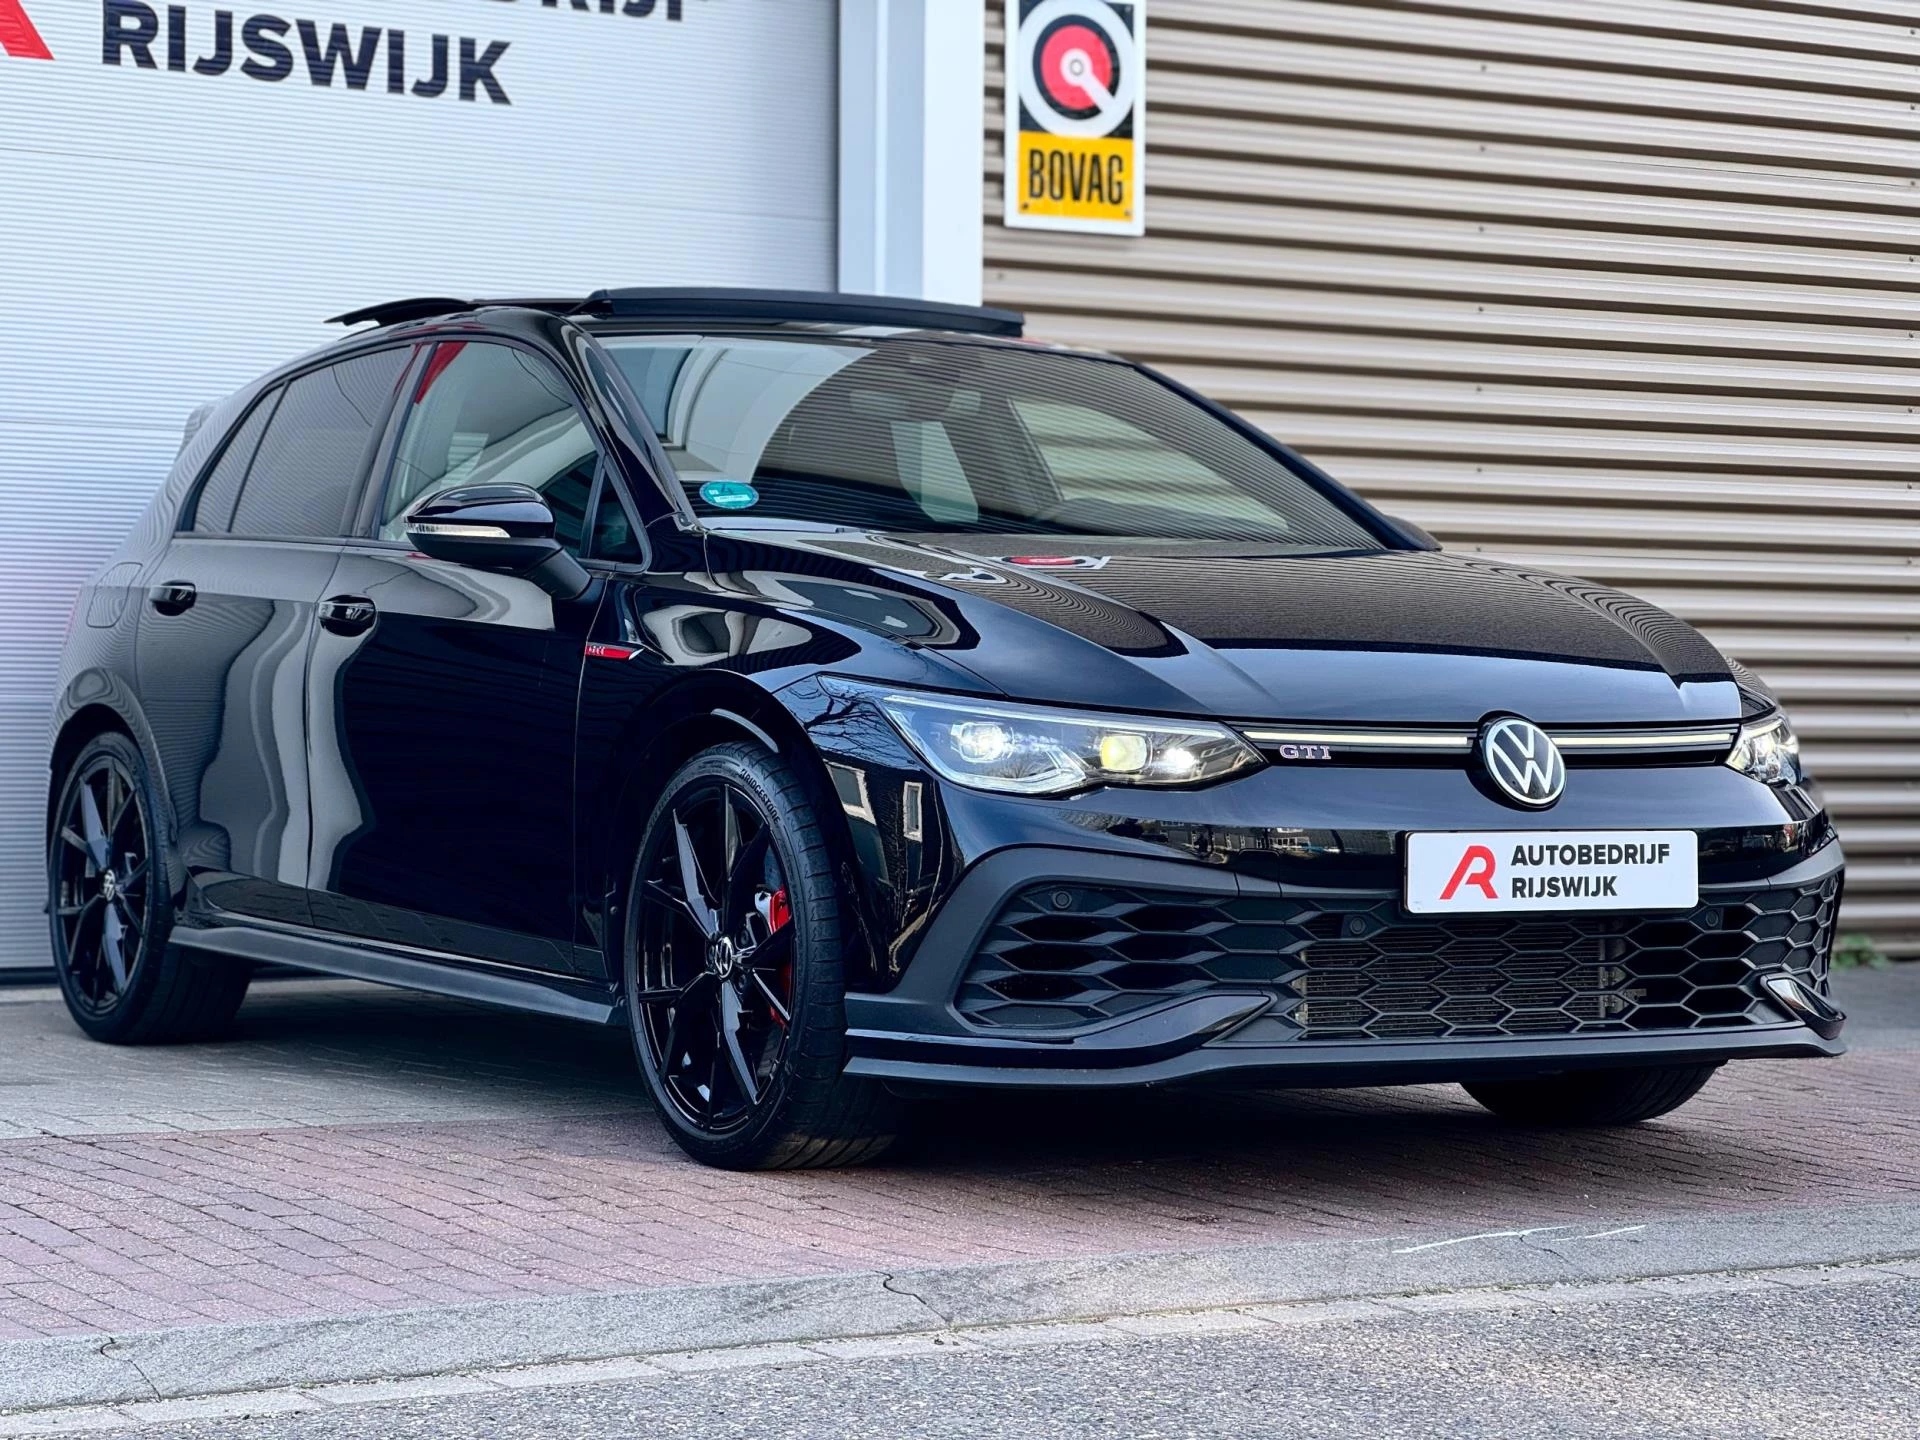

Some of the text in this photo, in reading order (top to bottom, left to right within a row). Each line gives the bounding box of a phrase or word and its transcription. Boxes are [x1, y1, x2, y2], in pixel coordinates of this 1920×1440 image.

[102, 0, 514, 105] RIJSWIJK
[1028, 148, 1124, 206] BOVAG
[1279, 743, 1332, 760] GTI
[1511, 843, 1670, 866] AUTOBEDRIJF
[1512, 875, 1618, 899] RIJSWIJK
